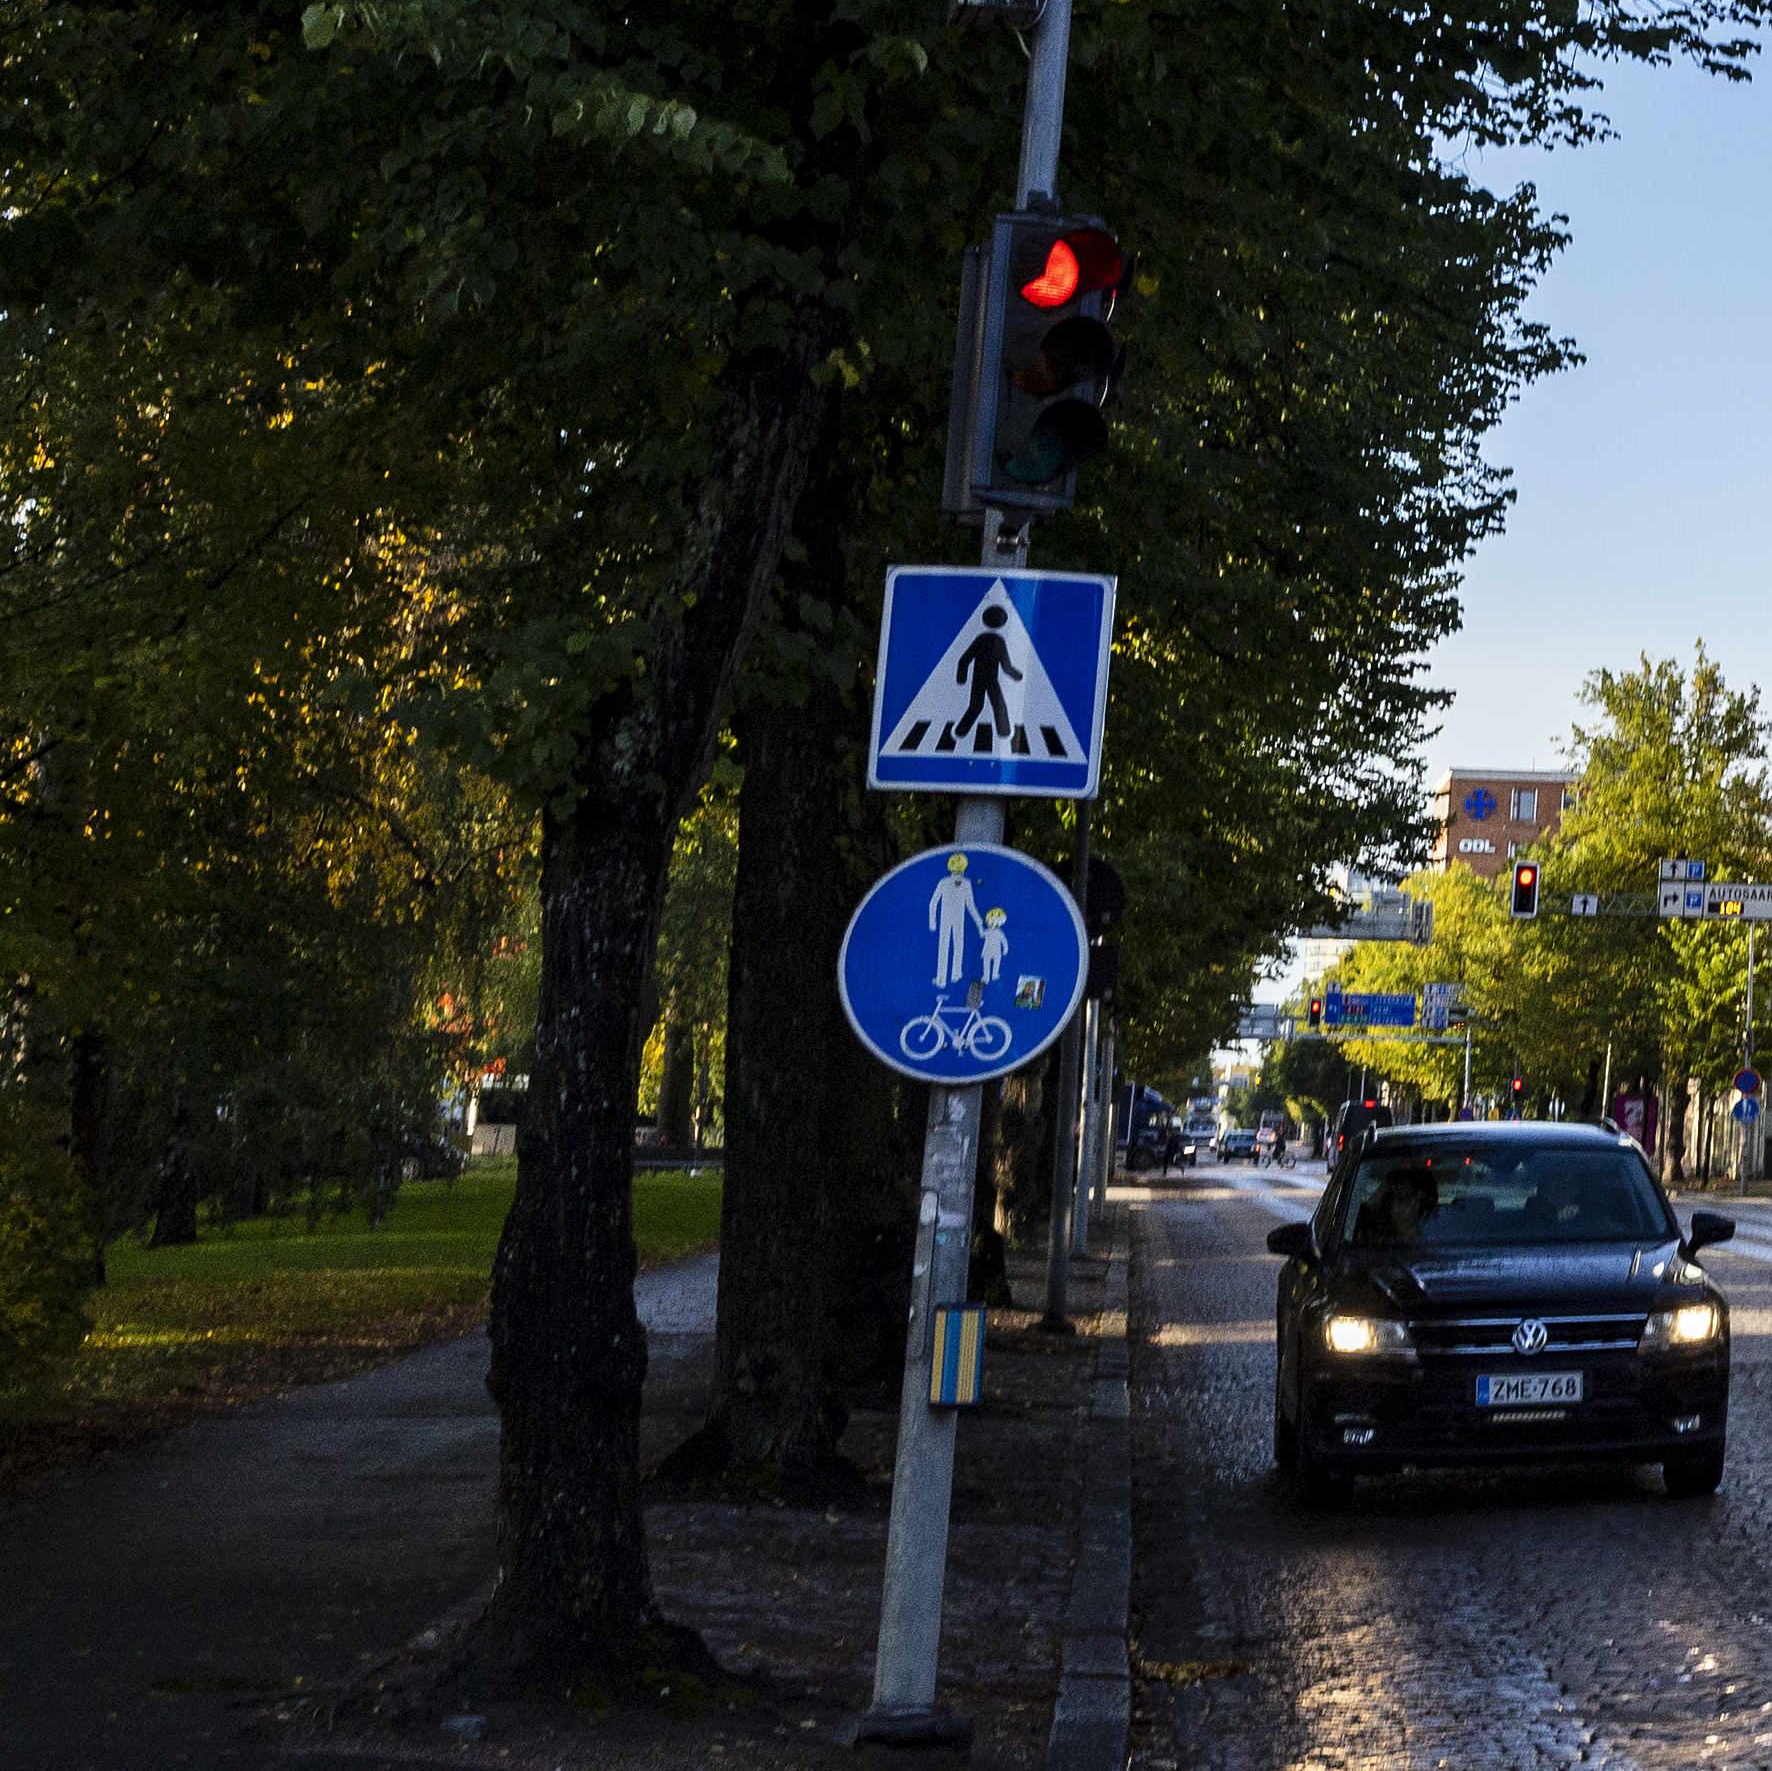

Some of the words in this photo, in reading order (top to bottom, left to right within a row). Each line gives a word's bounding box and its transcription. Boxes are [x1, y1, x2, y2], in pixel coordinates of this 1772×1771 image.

[1458, 837, 1497, 855] ODL
[1719, 900, 1742, 916] 104
[1493, 1378, 1577, 1401] ZME-768
